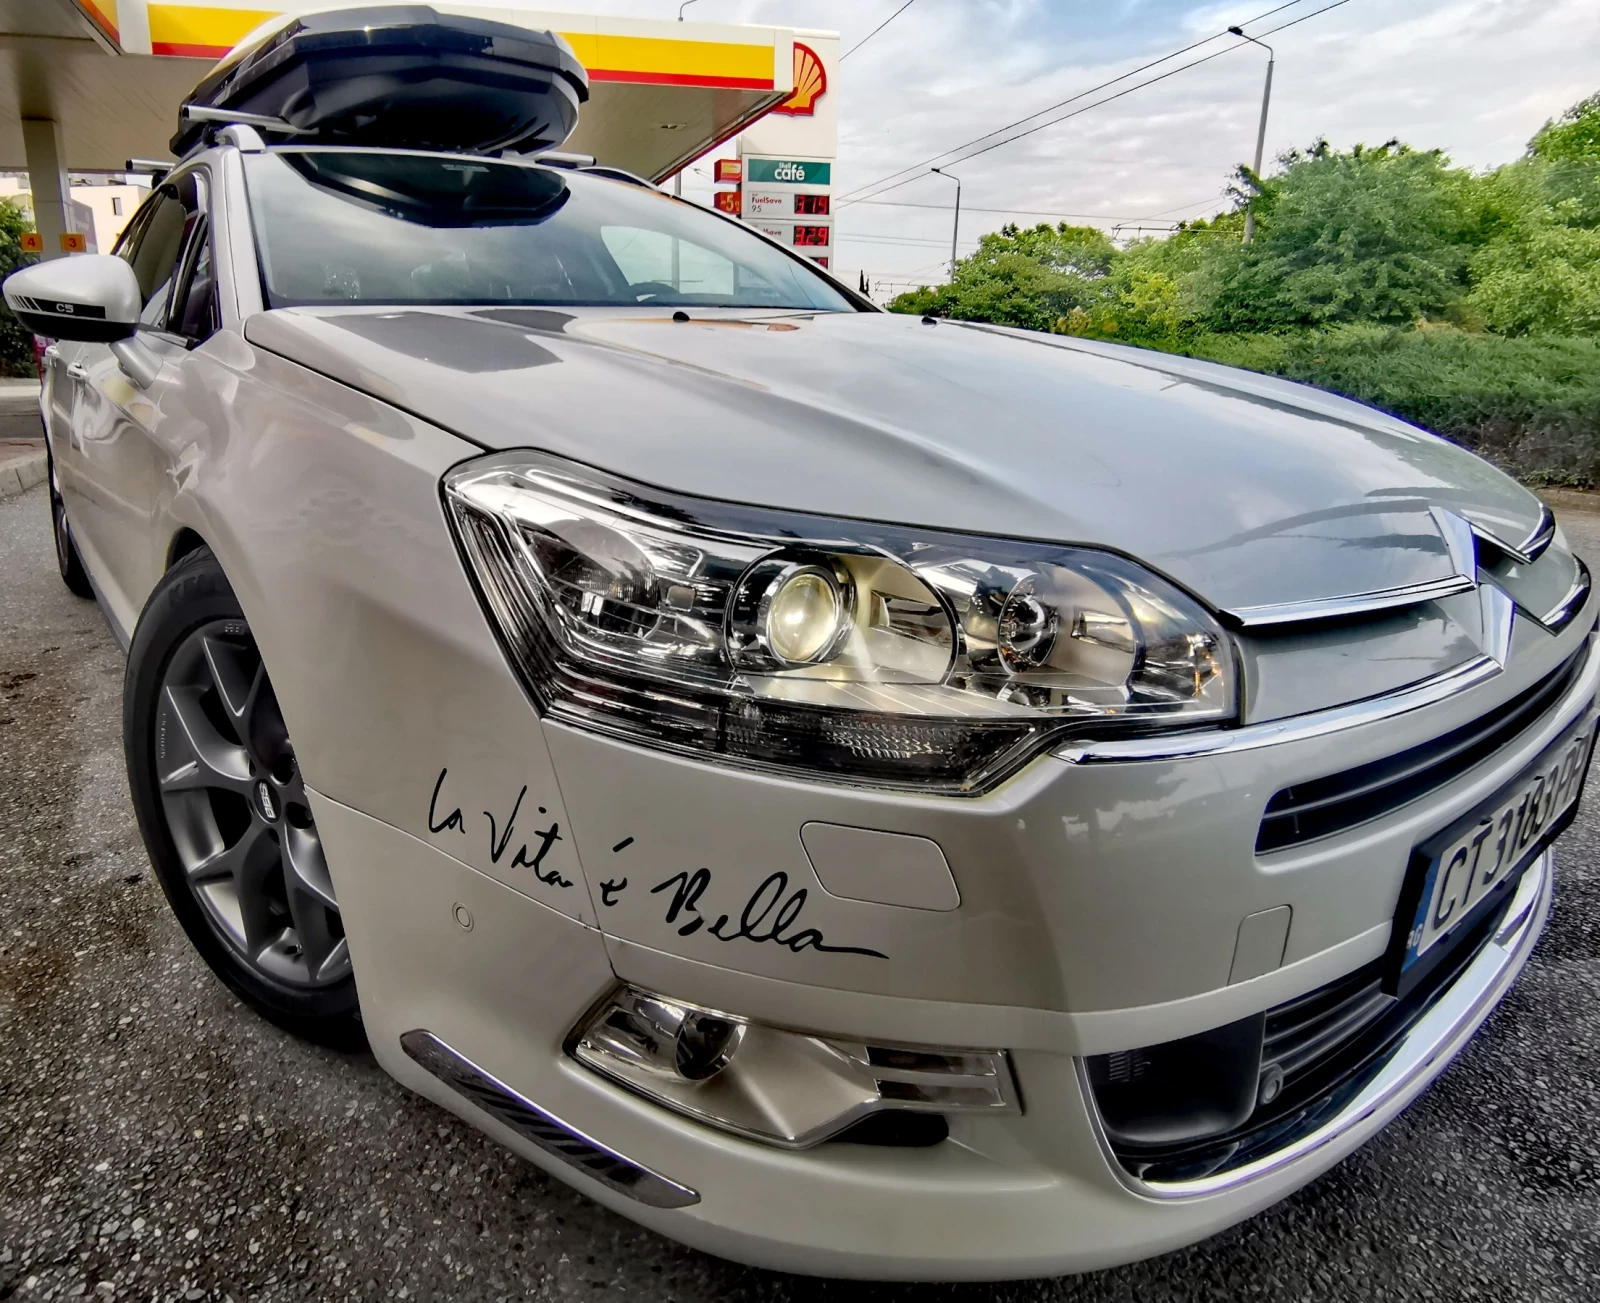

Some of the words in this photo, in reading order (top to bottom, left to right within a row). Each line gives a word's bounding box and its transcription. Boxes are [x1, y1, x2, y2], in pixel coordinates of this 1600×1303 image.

[775, 164, 805, 180] café
[752, 196, 782, 204] FuelSave
[752, 204, 762, 213] 95
[27, 237, 36, 248] 4
[68, 237, 77, 248] 3
[56, 303, 74, 313] C5
[428, 768, 466, 834] La
[483, 785, 574, 888] Vita
[650, 867, 890, 960] Bella
